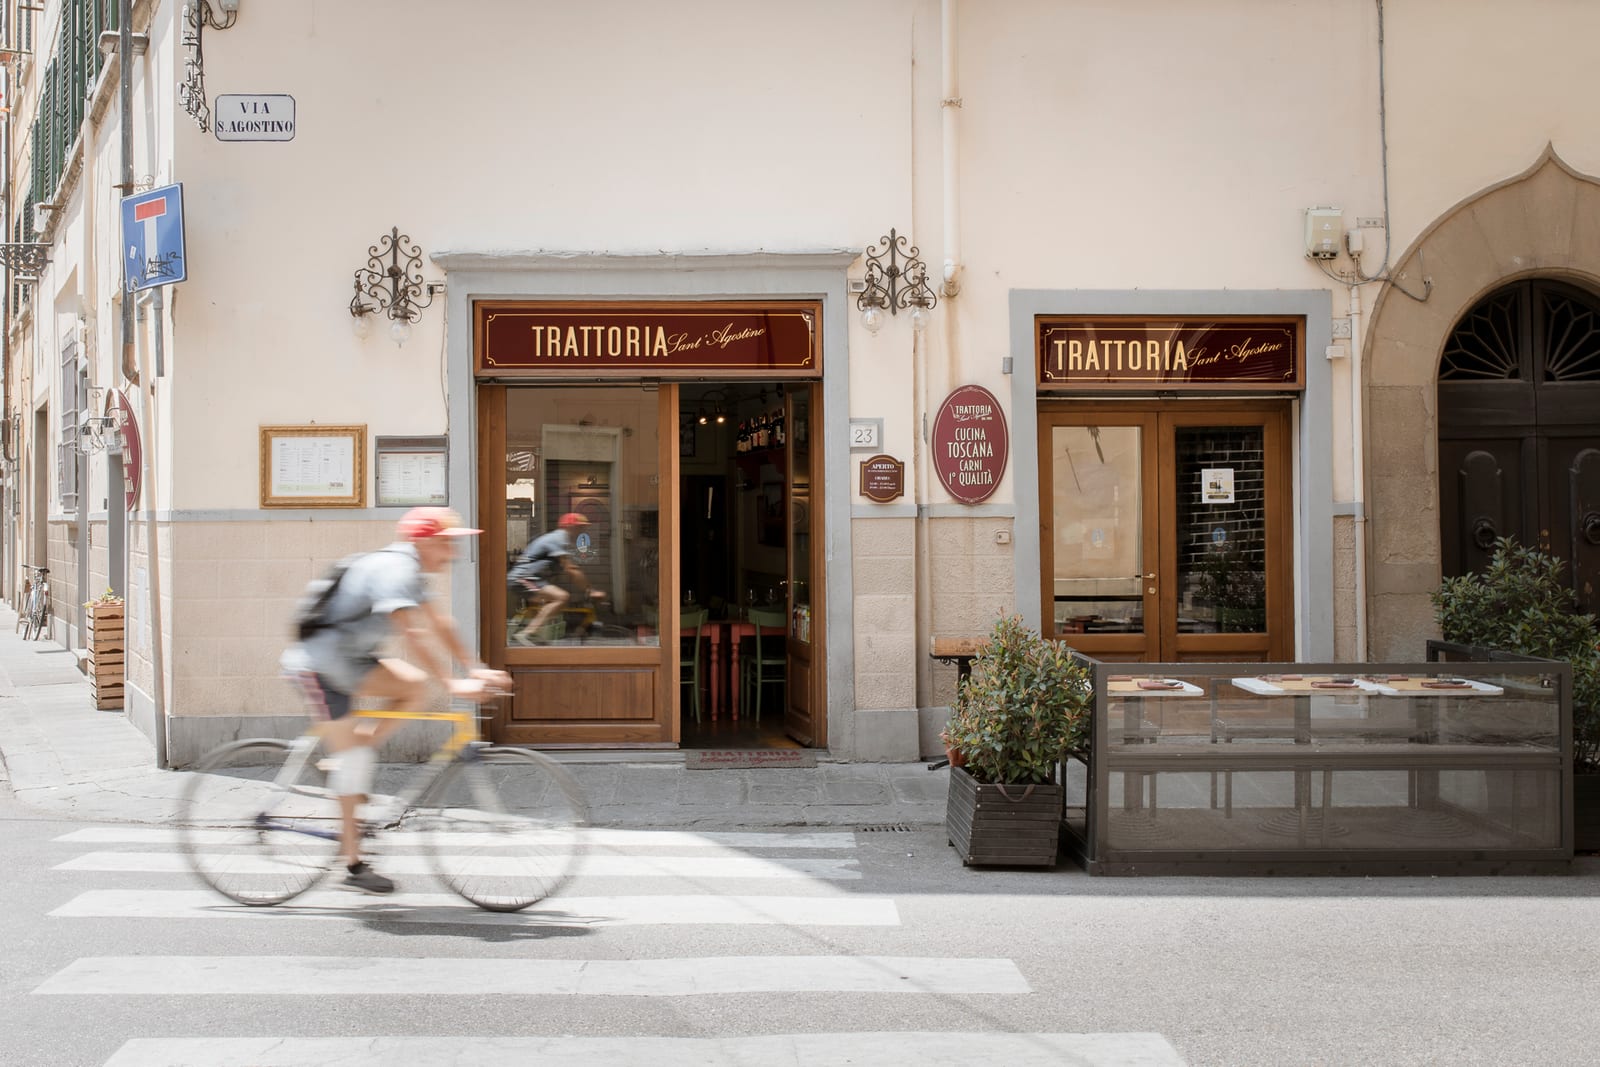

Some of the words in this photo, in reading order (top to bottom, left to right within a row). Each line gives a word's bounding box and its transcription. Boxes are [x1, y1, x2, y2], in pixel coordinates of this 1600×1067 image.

[240, 102, 270, 114] VIA
[217, 120, 293, 133] S.AGOSTINO
[1332, 322, 1350, 335] 25
[531, 325, 668, 357] TRATTORIA
[1053, 340, 1188, 371] TRATTORIA
[955, 405, 992, 415] TRATTORIA
[854, 428, 873, 444] 23
[954, 427, 986, 441] CUCINA
[947, 441, 993, 458] TOSCANA
[959, 459, 983, 471] CARNI
[958, 470, 993, 487] QUALITÀ
